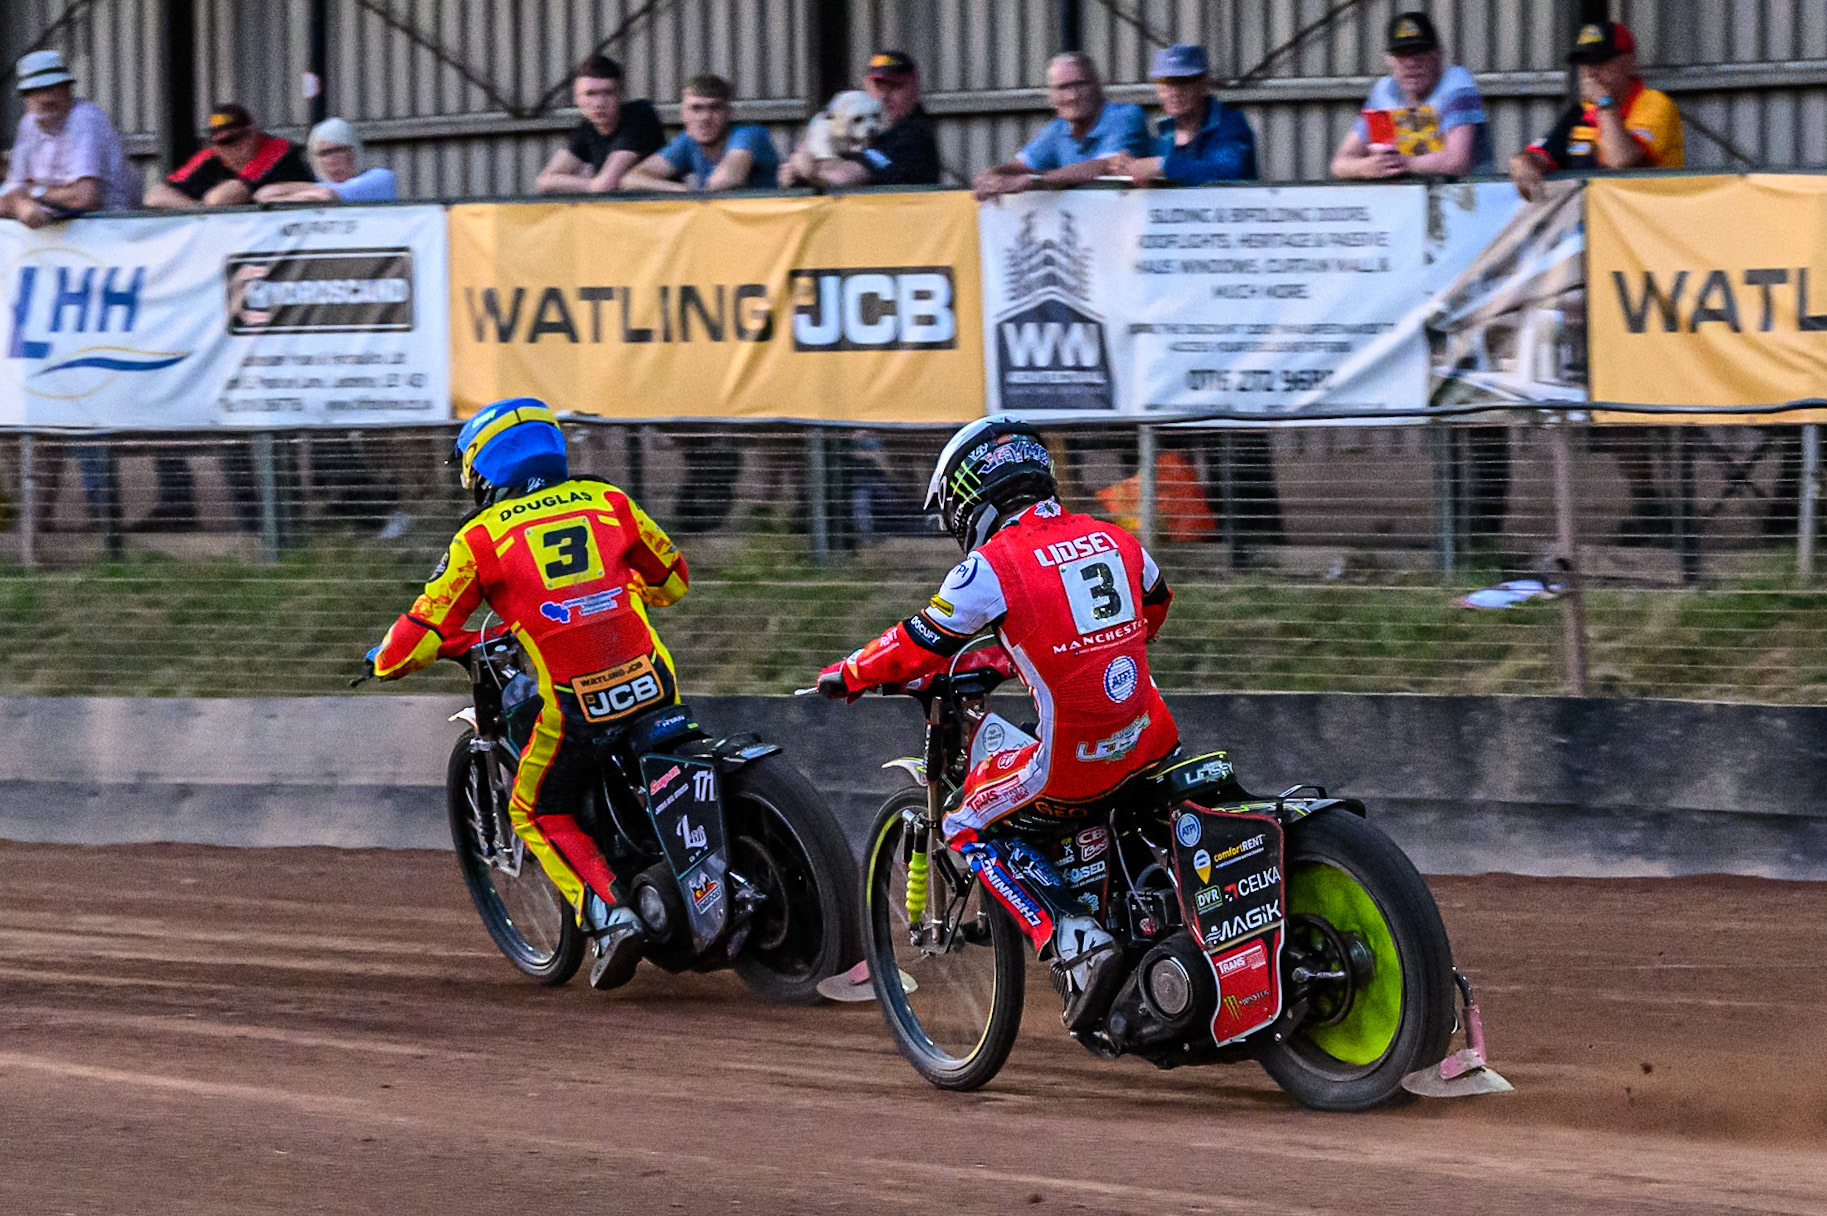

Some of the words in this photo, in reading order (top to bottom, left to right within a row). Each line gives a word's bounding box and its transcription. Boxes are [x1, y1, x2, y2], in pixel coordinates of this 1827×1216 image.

[464, 283, 775, 344] WATLING
[793, 273, 956, 345] JCB
[499, 491, 593, 522] DOUGLAS
[543, 525, 589, 579] 3
[1079, 562, 1122, 621] 3
[588, 674, 658, 716] JCB
[1197, 888, 1220, 908] DVR
[1238, 866, 1282, 896] CELKA
